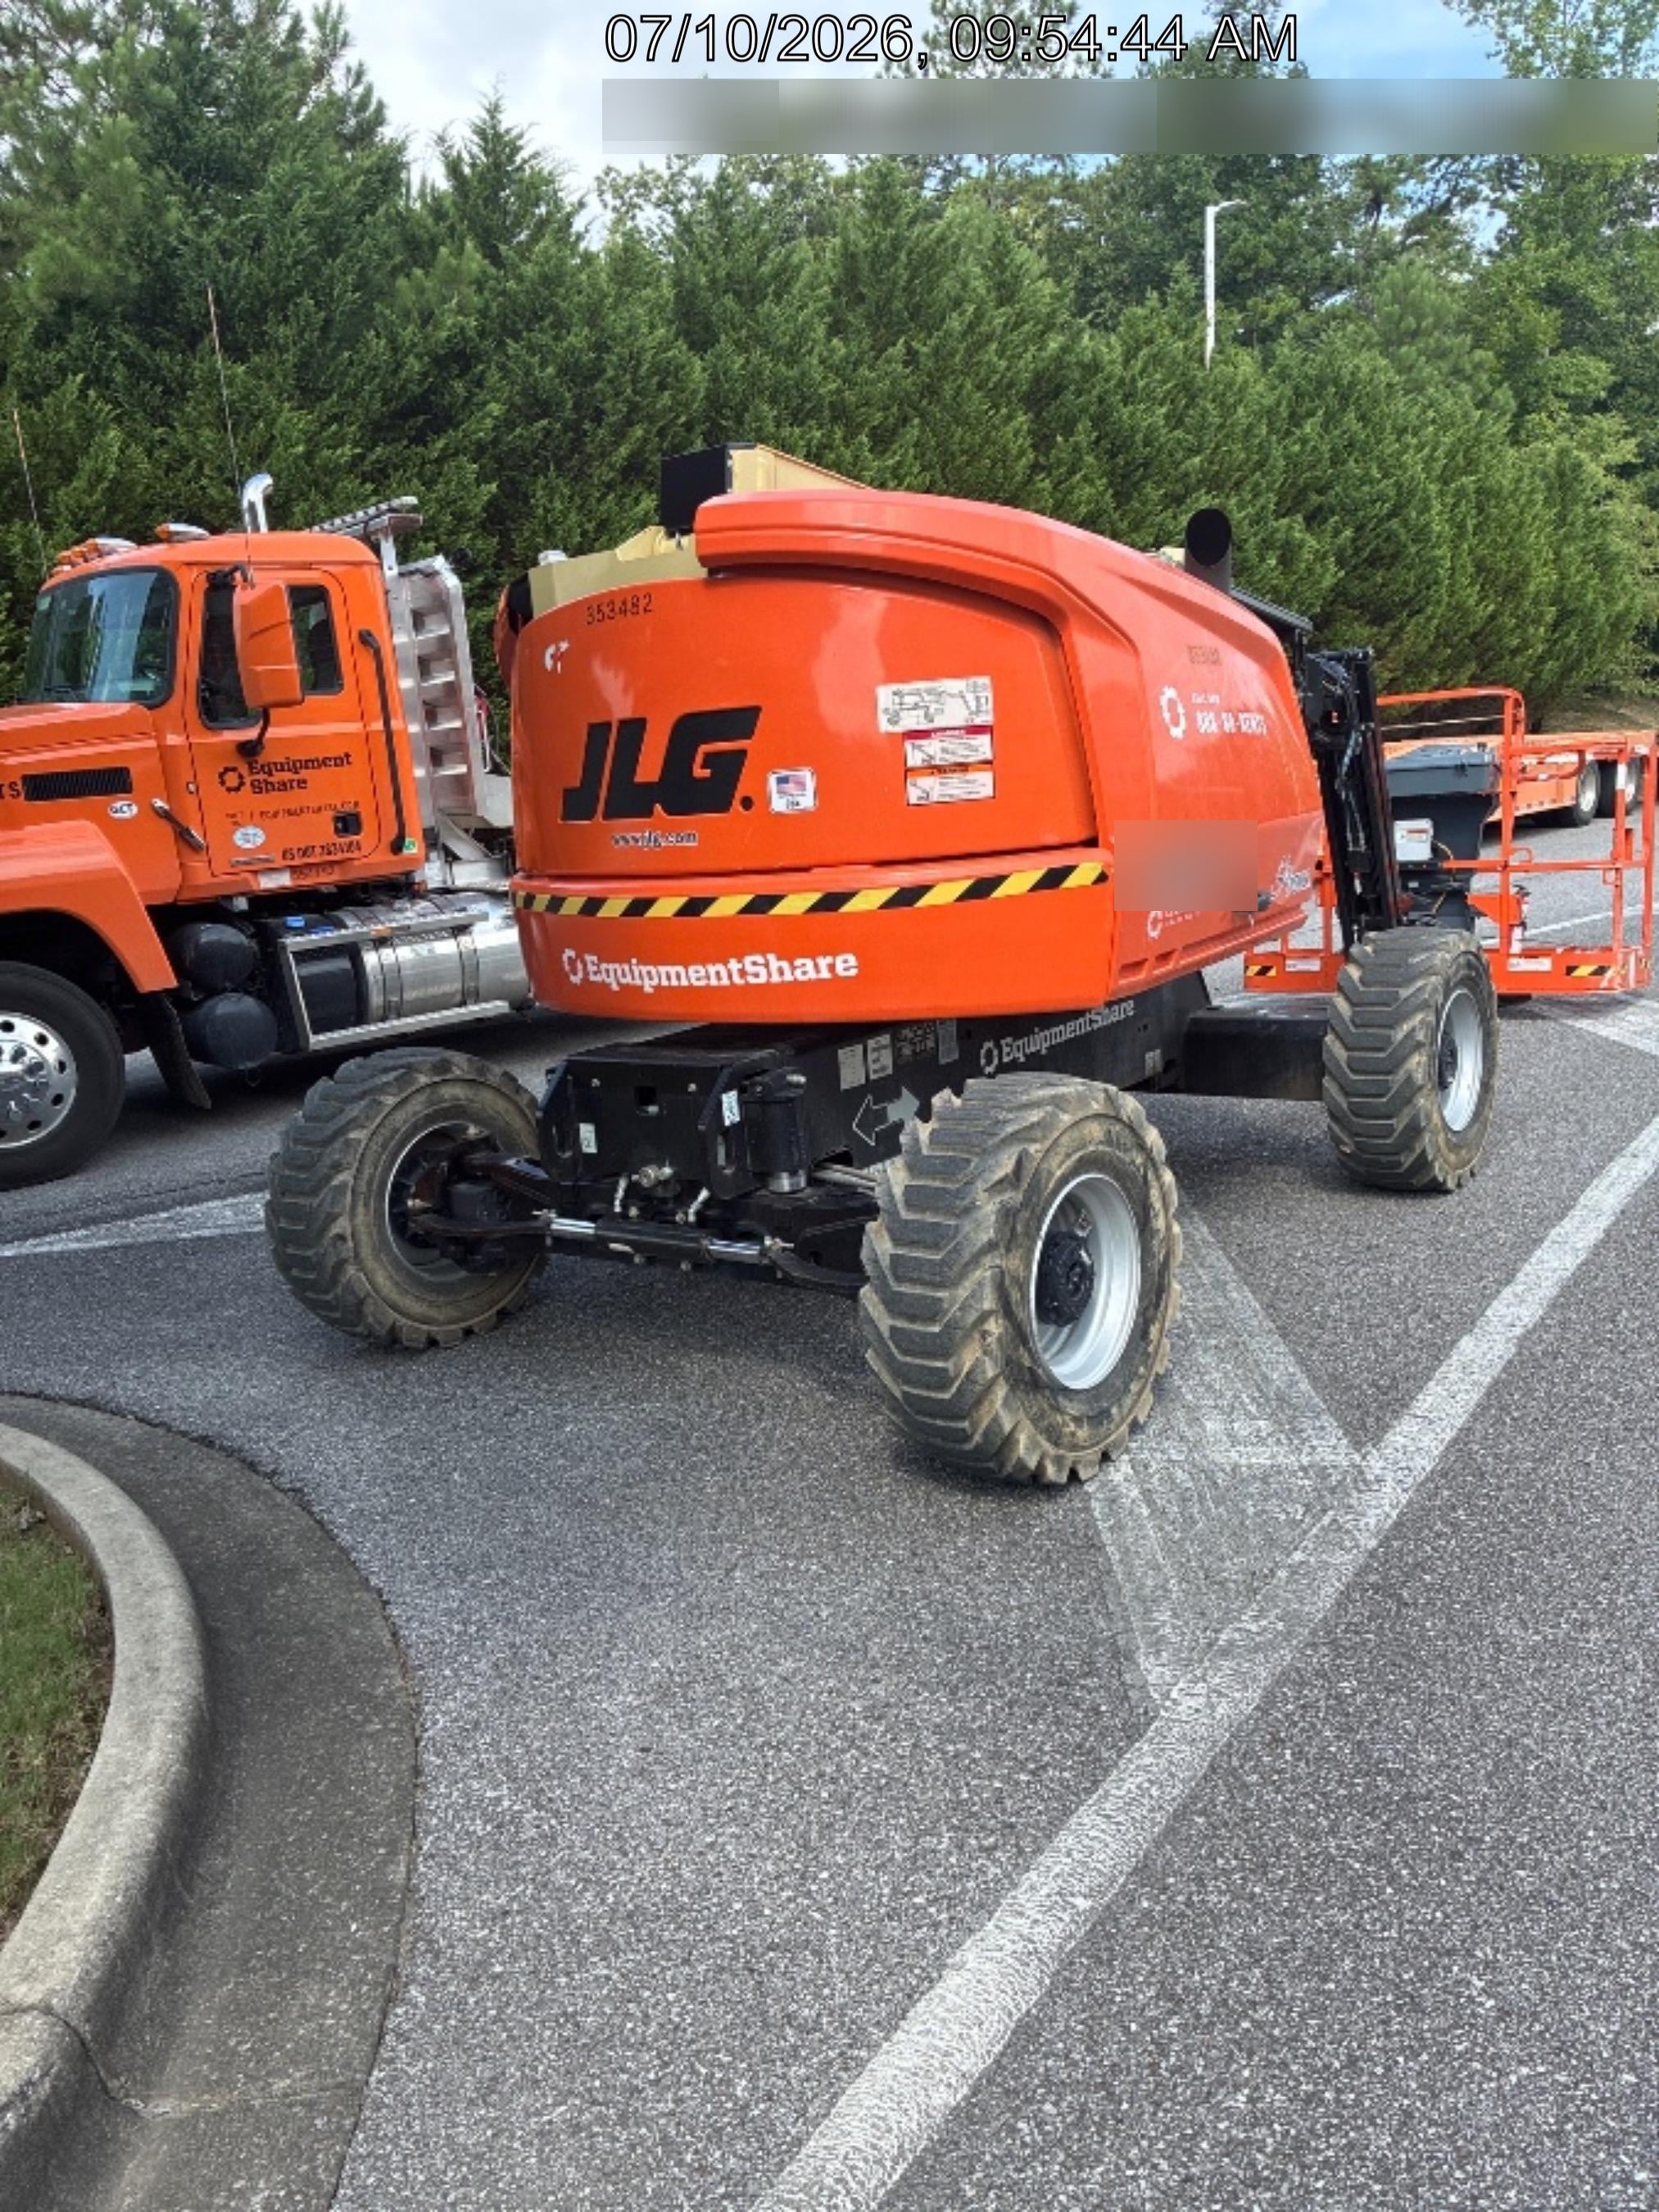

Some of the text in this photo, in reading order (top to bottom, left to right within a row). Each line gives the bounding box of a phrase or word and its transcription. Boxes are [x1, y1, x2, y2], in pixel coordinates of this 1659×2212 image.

[586, 592, 653, 625] 353482
[247, 752, 352, 777] Equipment
[250, 777, 308, 795] Share
[585, 953, 859, 993] EquipmentShare
[999, 999, 1135, 1063] EquipmentShare
